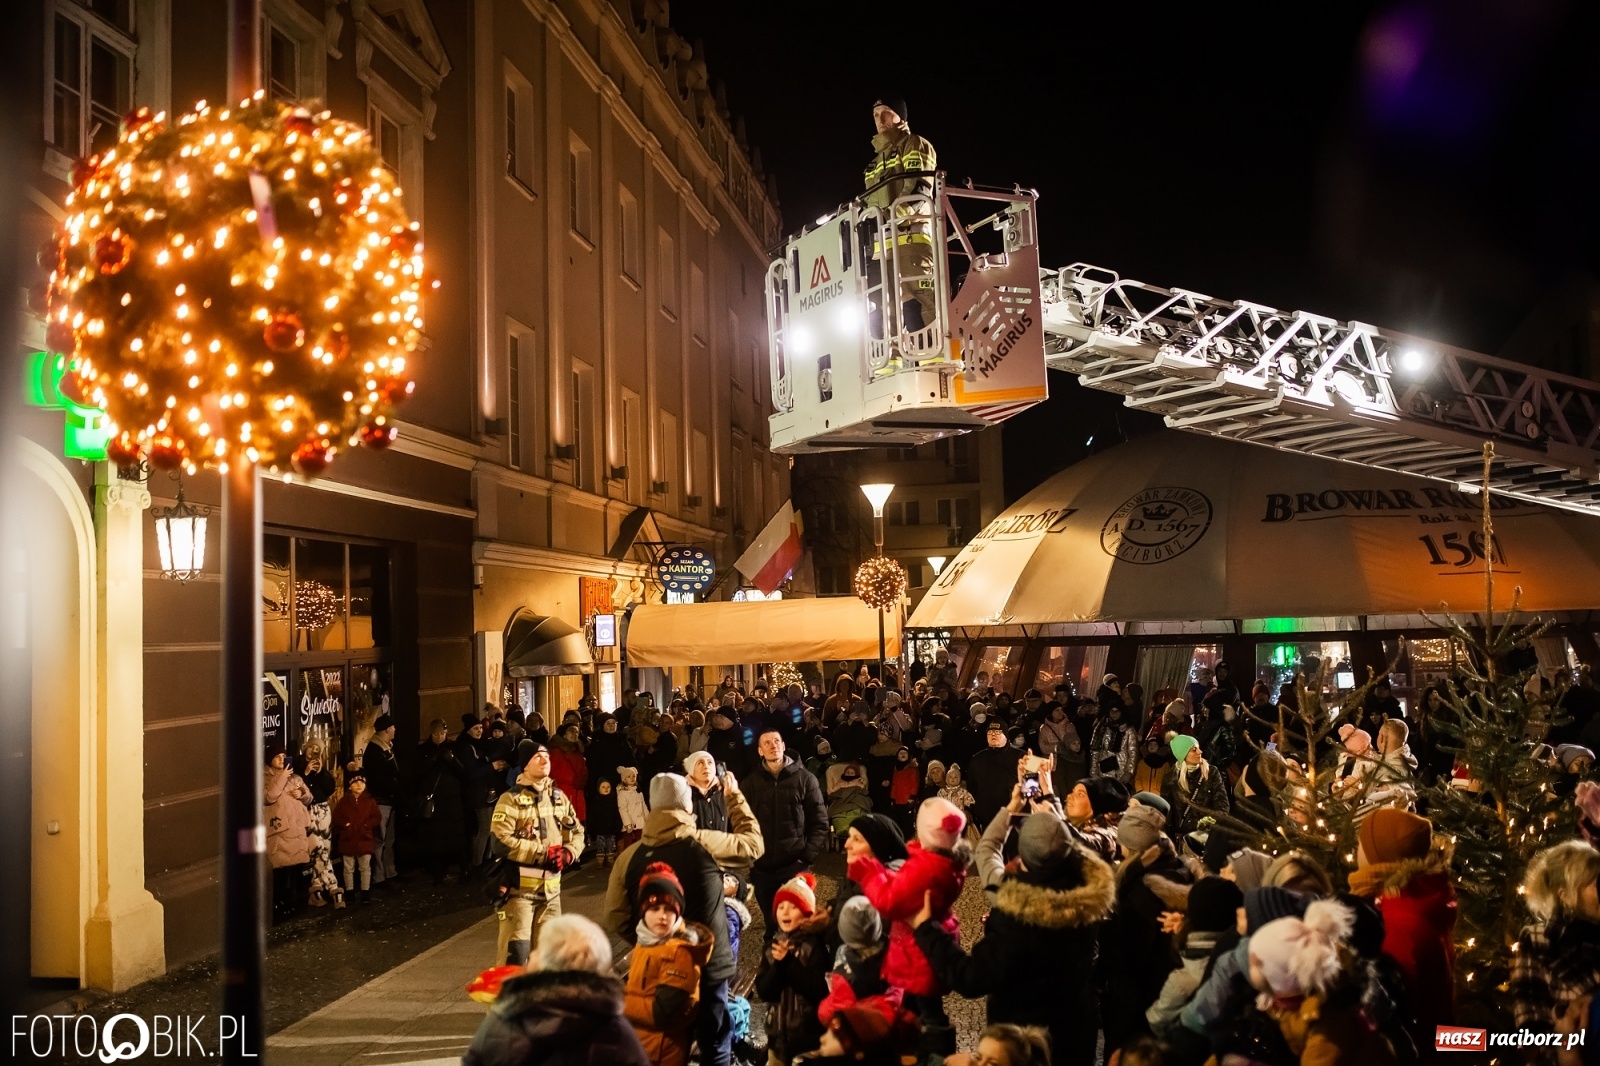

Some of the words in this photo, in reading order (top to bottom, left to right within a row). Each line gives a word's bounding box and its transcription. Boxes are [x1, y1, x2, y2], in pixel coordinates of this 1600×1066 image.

[800, 280, 844, 313] MAGIRUS
[979, 313, 1033, 378] MAGIRUS
[1114, 489, 1160, 518] BROWAR
[1261, 487, 1423, 522] BROWAR
[1127, 518, 1146, 532] D.
[1154, 516, 1201, 538] 1567
[1418, 513, 1452, 524] Rok
[668, 564, 704, 574] KANTOR
[262, 714, 280, 728] RING
[300, 690, 341, 728] Sylwester
